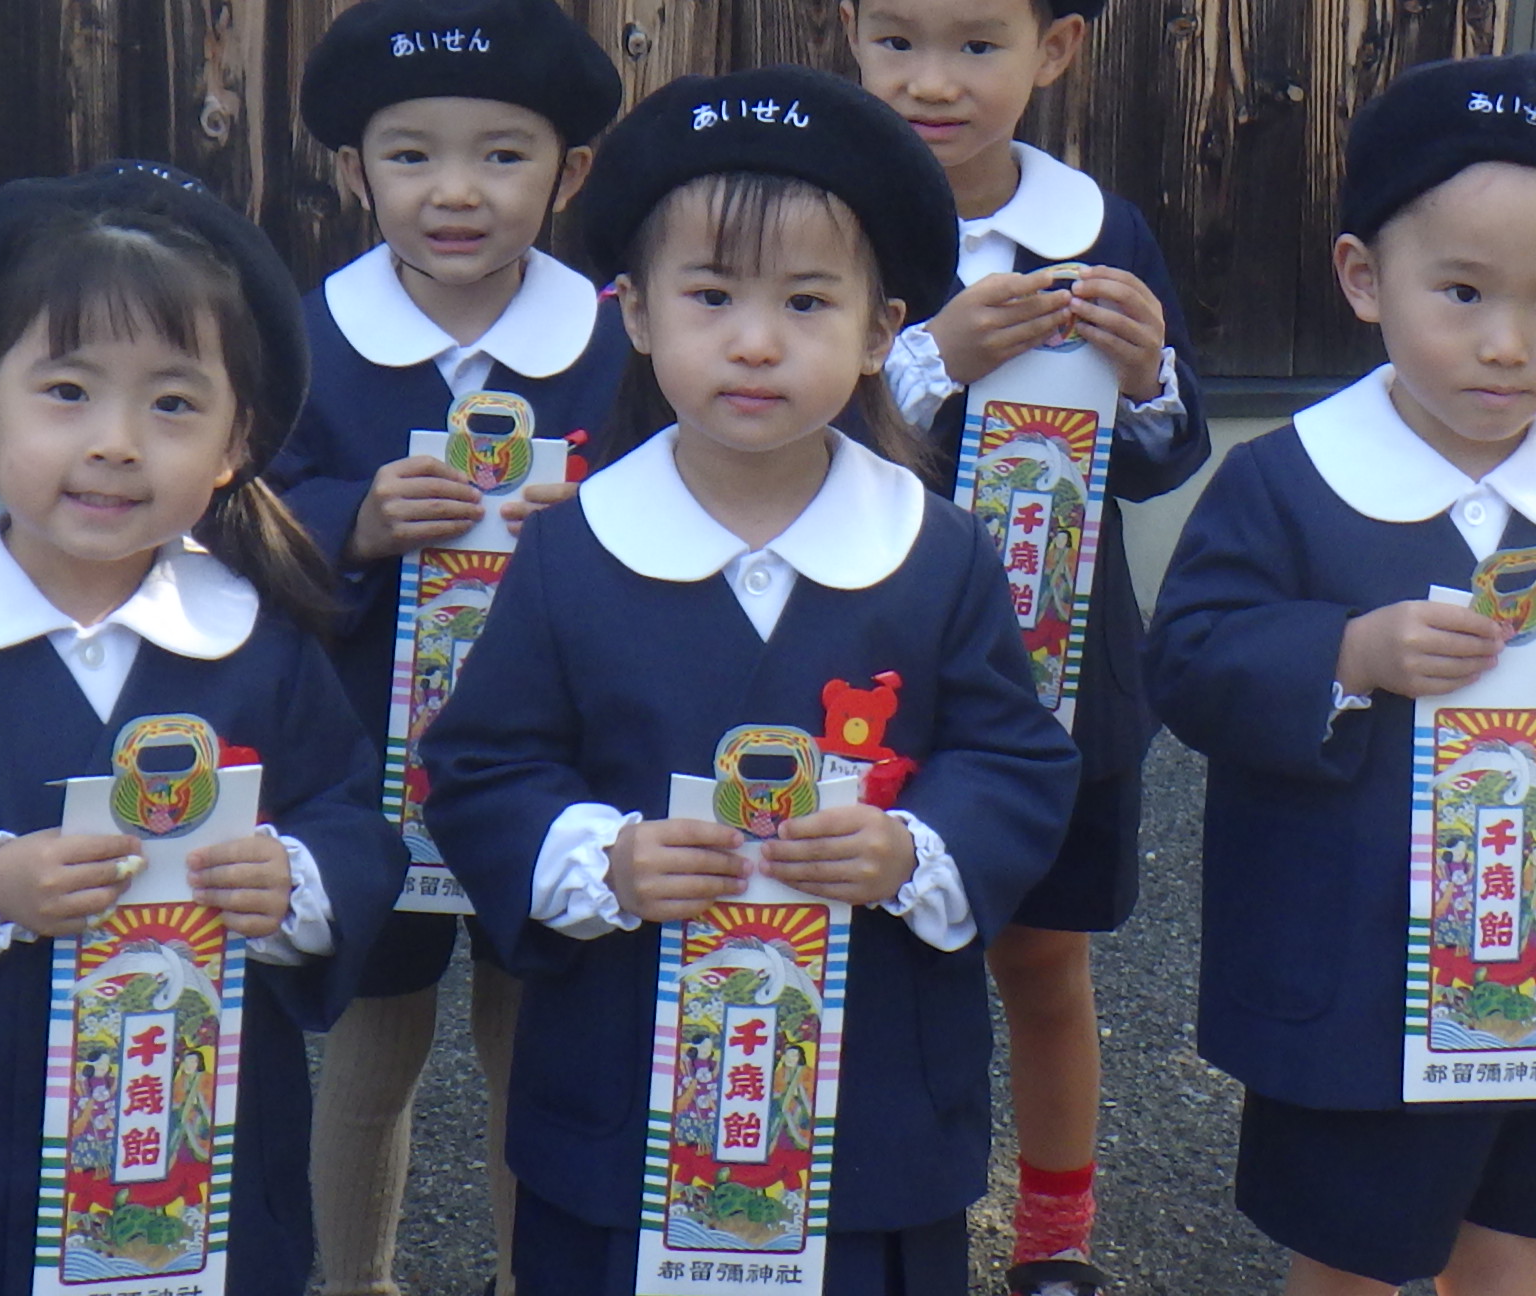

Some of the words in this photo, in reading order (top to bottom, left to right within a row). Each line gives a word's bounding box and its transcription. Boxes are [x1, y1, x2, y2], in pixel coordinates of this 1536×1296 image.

[390, 27, 491, 58] あいせん
[691, 98, 811, 131] あいせん
[1479, 818, 1518, 949] 千歳飴
[121, 1023, 168, 1167] 千歳飴
[722, 1018, 769, 1150] 千歳飴
